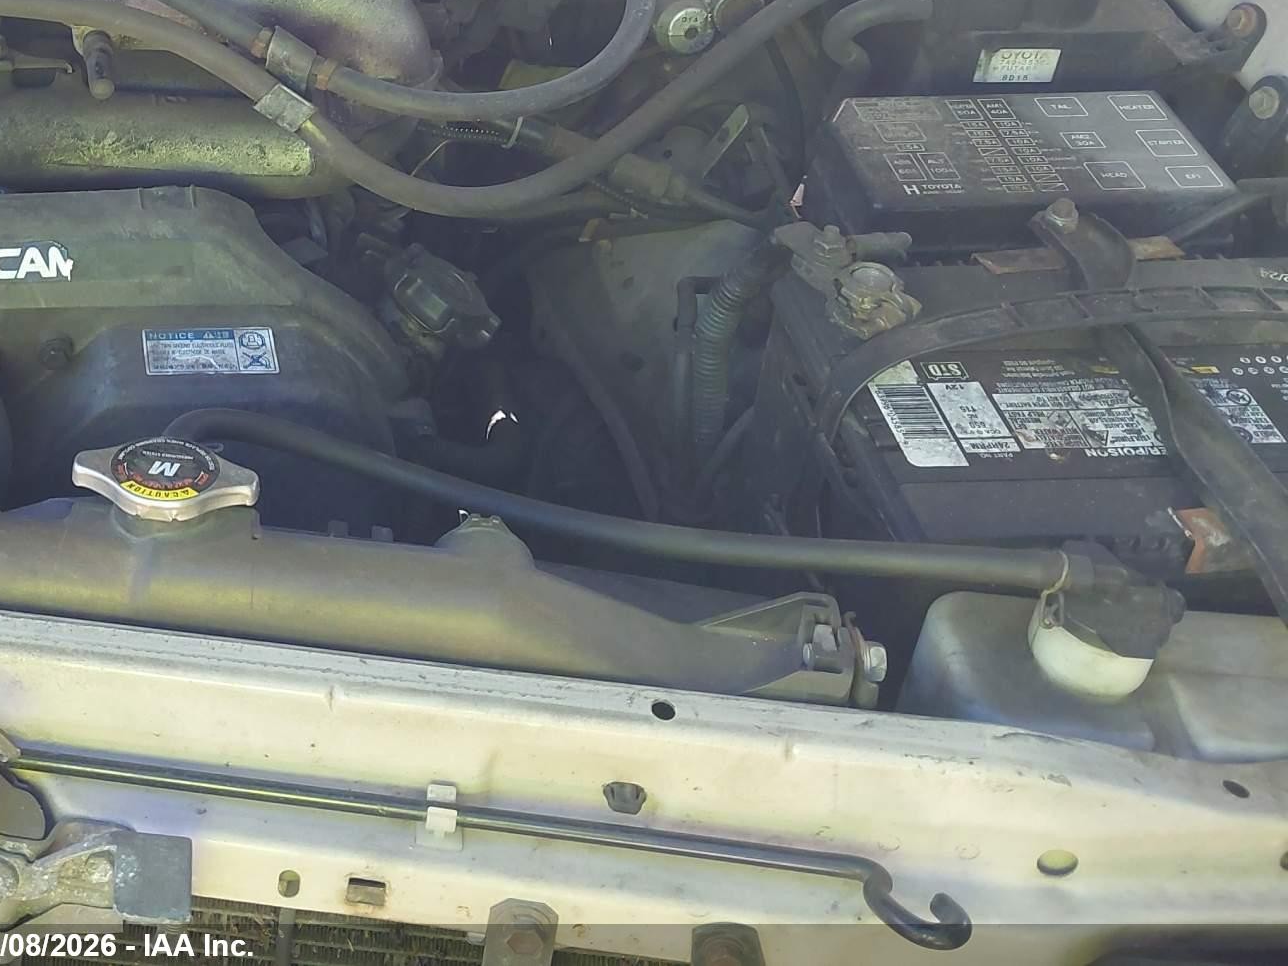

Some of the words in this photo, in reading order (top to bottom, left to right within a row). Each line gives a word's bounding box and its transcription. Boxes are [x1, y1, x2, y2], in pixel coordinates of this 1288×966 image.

[149, 332, 195, 340] NOTICE
[927, 364, 962, 376] STD
[148, 459, 180, 477] M
[127, 484, 180, 498] CAUTION
